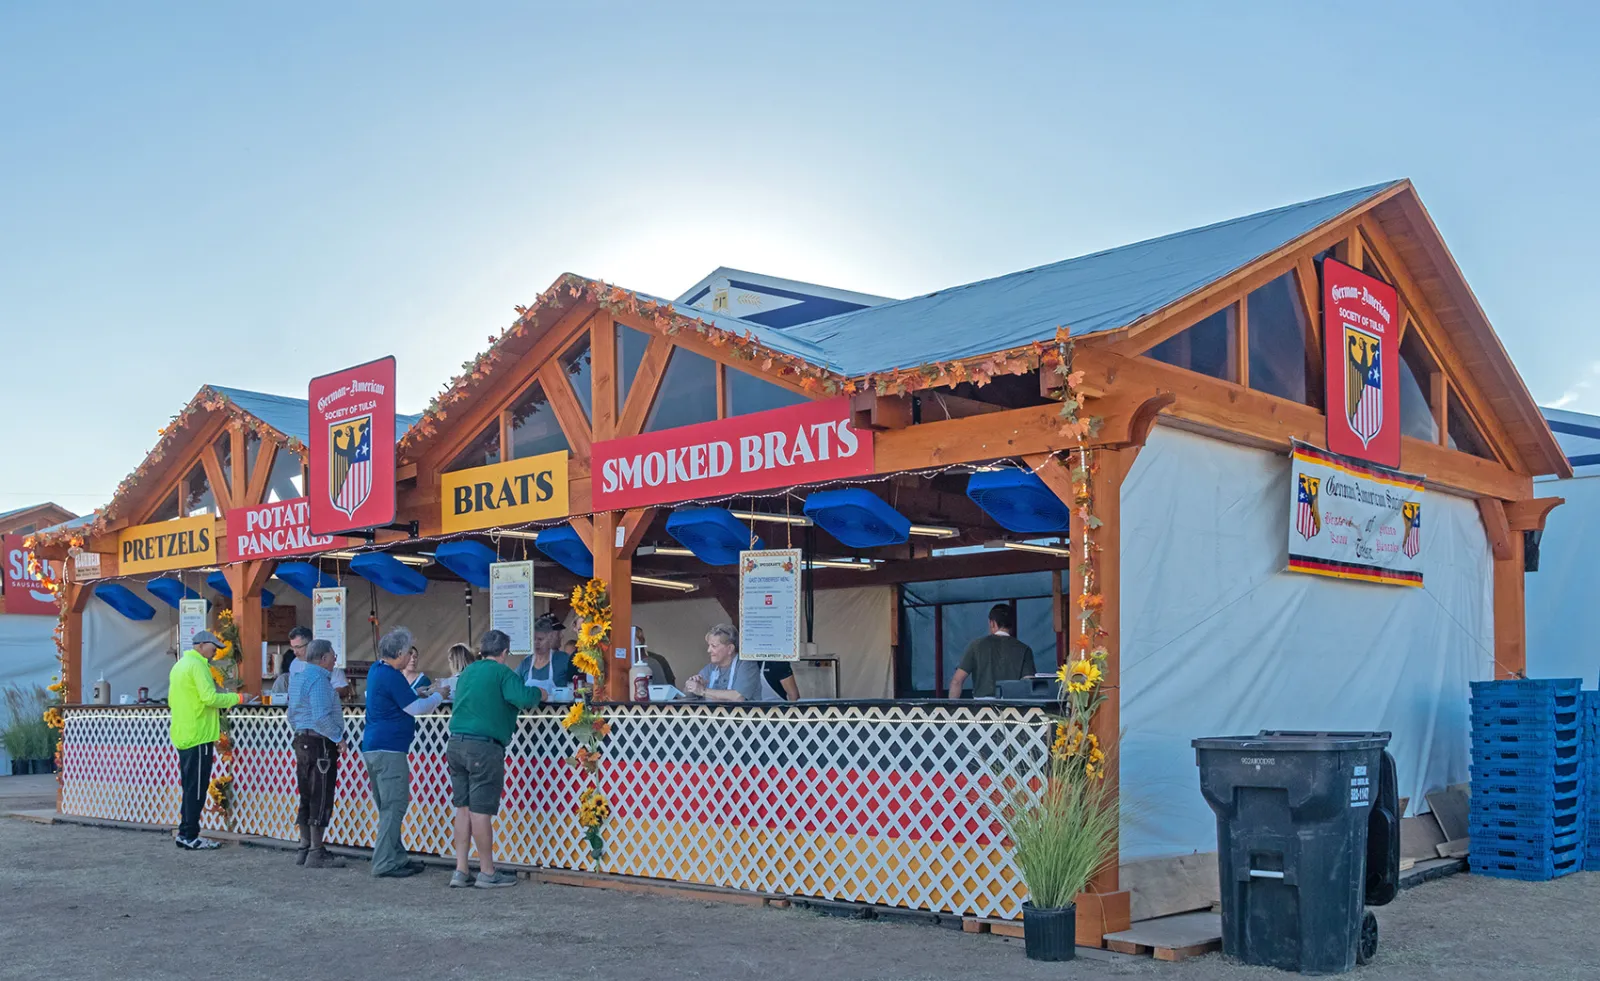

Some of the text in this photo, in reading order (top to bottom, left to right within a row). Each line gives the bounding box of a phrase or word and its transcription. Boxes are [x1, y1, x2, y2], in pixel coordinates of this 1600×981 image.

[1332, 284, 1390, 324] German-American
[1339, 307, 1385, 333] SOCIETY OF TULSA
[317, 380, 385, 413] German-American
[325, 400, 377, 420] SOCIETY OF TULSA
[602, 418, 859, 493] SMOKED BRATS
[453, 470, 553, 516] BRATS
[246, 502, 311, 532] POTAT
[123, 527, 210, 563] PRETZELS
